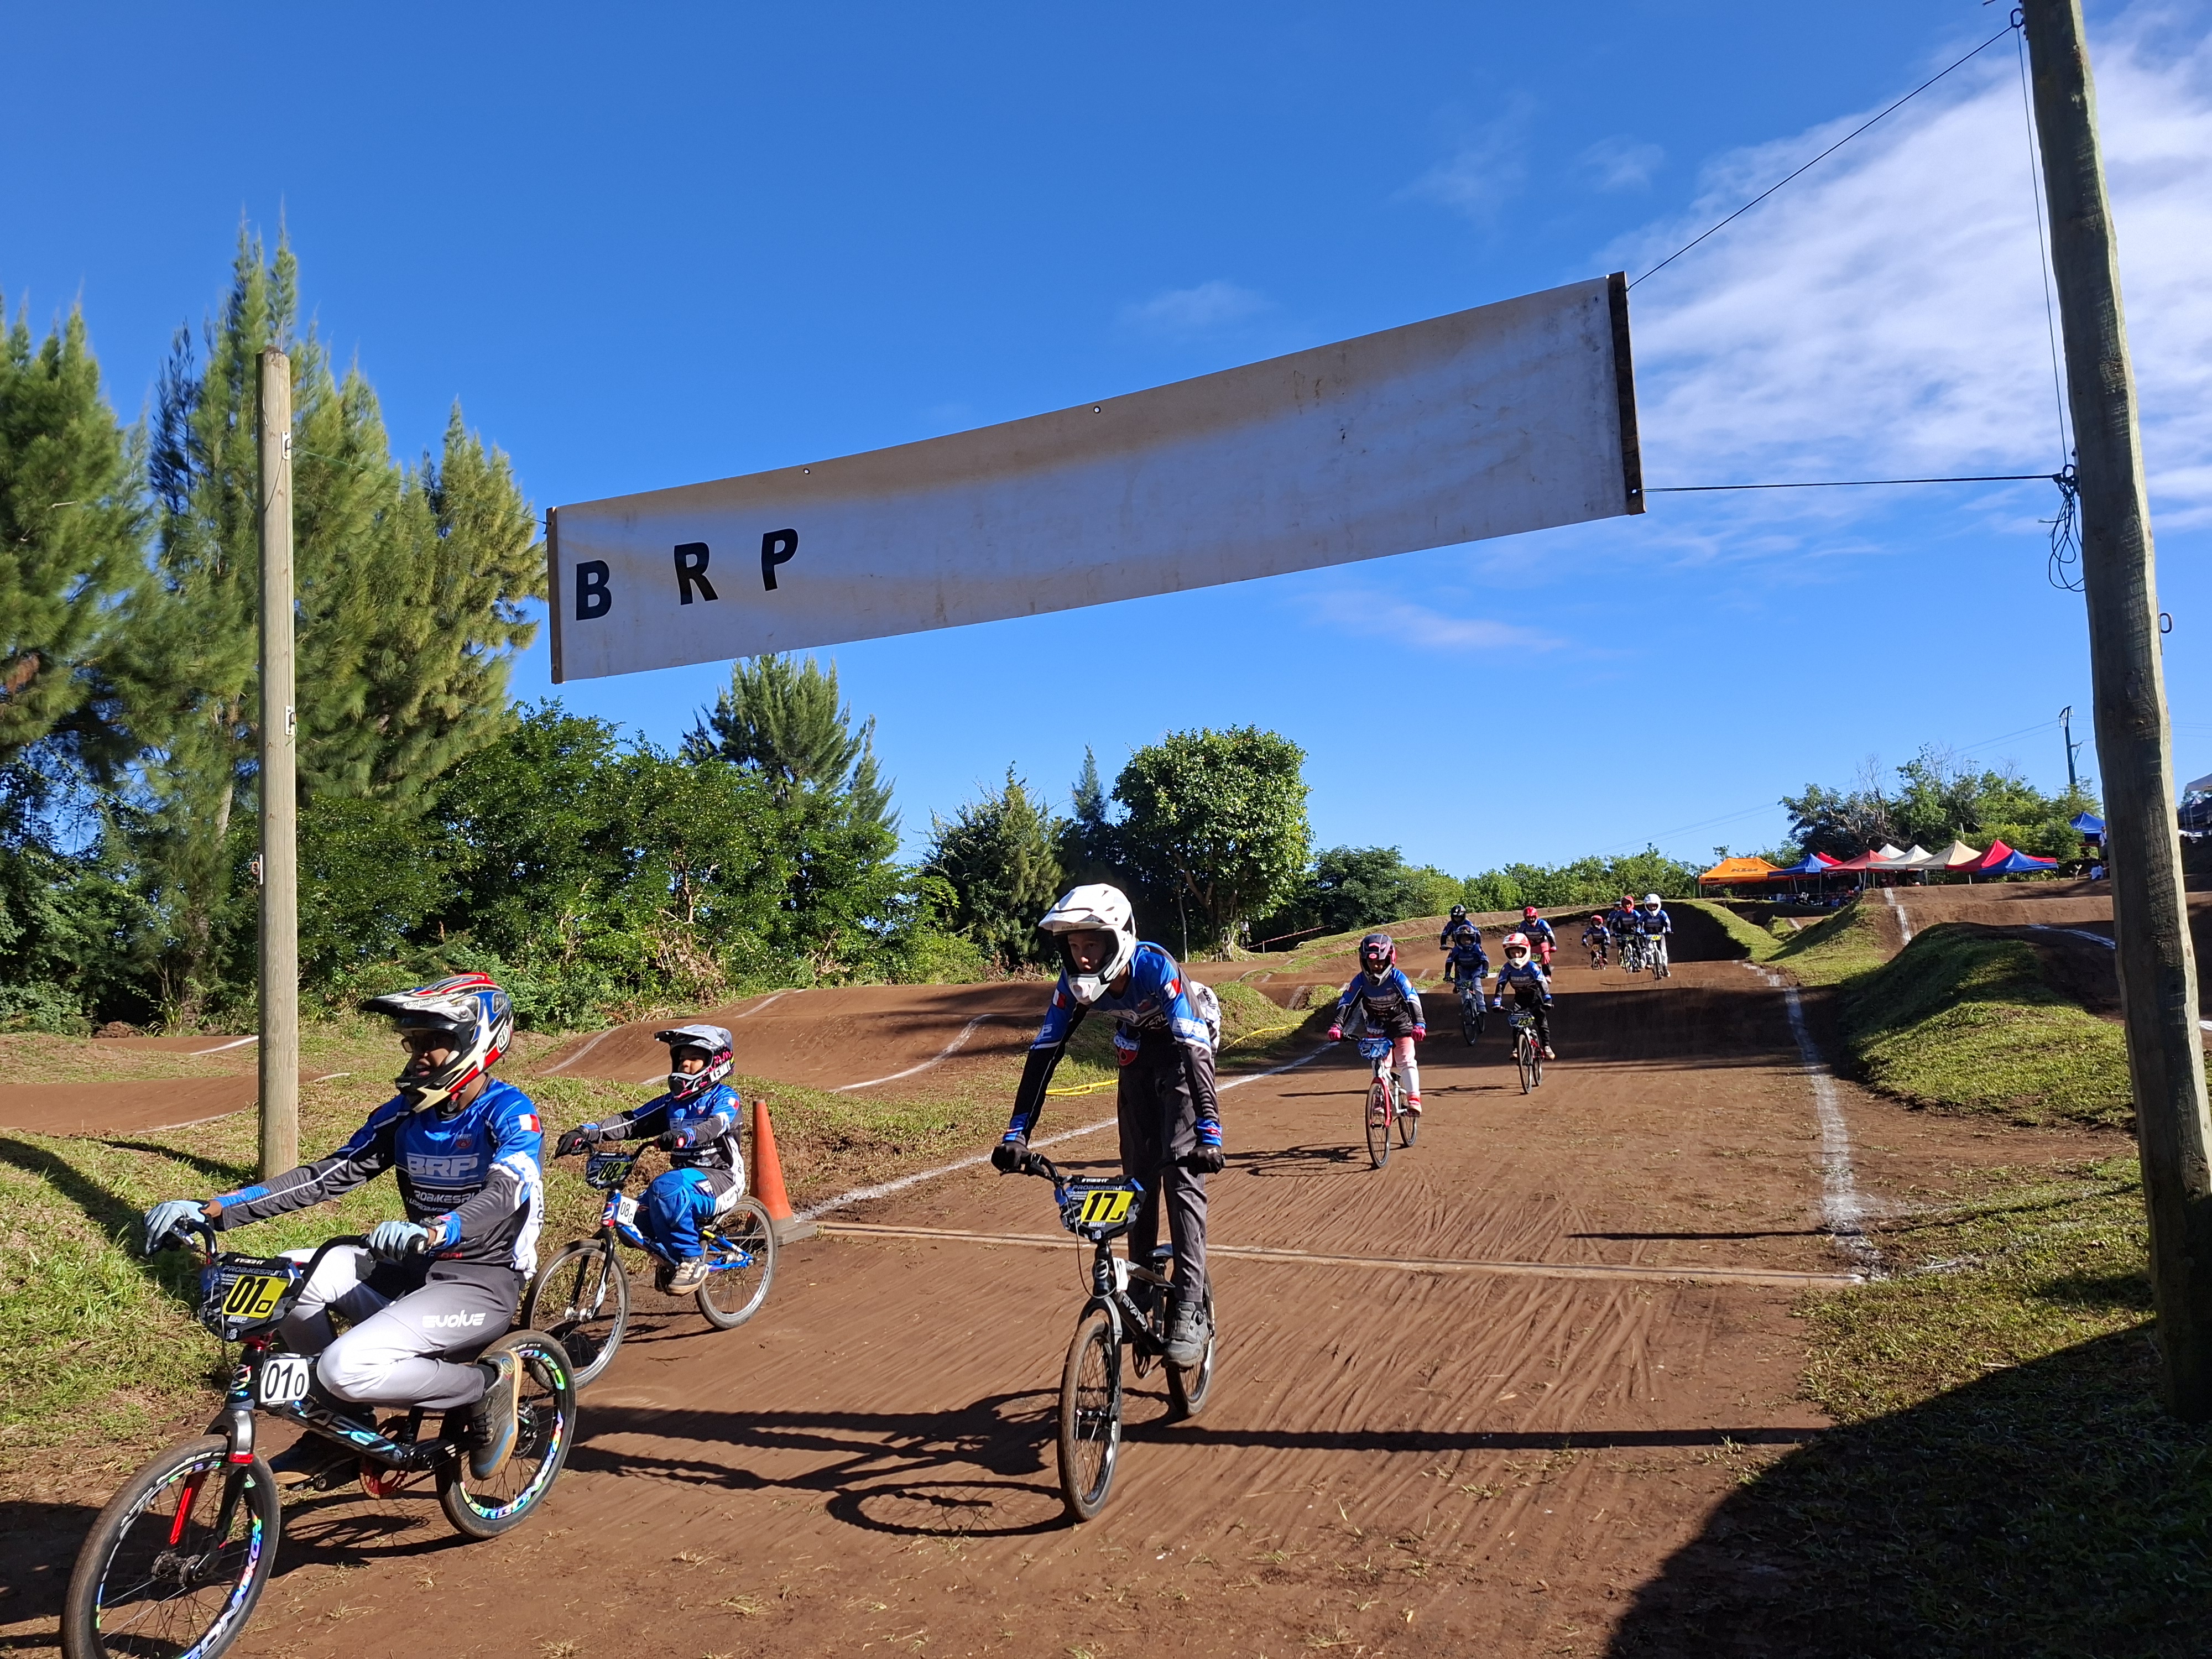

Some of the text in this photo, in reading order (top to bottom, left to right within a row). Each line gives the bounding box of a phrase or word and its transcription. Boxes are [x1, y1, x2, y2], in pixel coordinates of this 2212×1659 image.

[709, 1060, 731, 1083] KENNY
[407, 1155, 478, 1177] BRP
[227, 1315, 248, 1323] BRP
